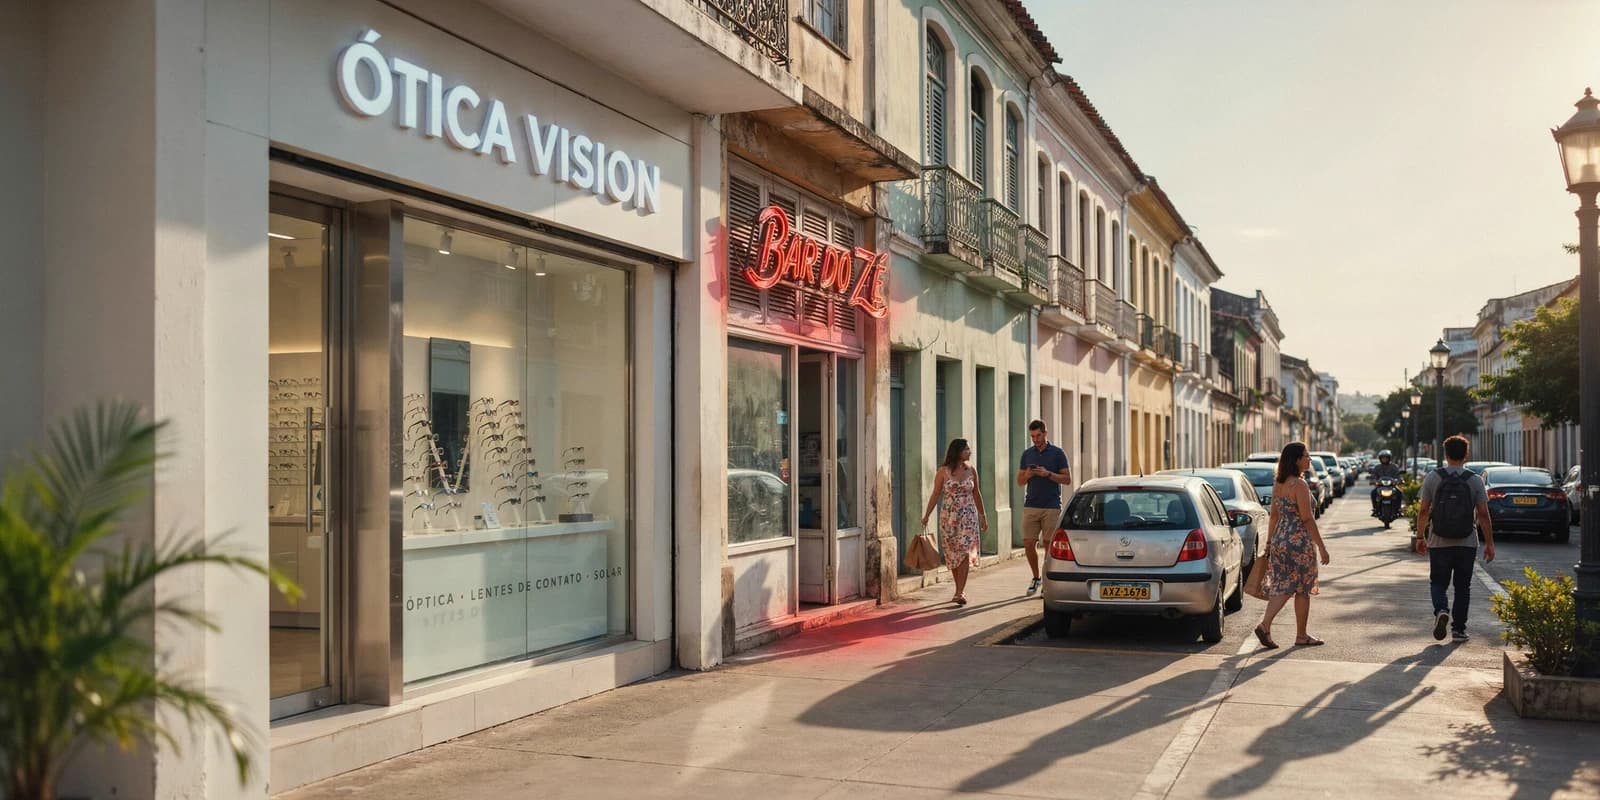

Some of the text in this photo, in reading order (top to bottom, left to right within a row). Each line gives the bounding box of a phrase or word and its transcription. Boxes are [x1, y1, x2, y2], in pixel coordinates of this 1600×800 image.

[337, 29, 661, 214] ÓTICA VISION
[470, 583, 513, 601] LENTES
[518, 580, 531, 593] DE
[535, 572, 582, 590] CONTATO
[593, 566, 623, 581] SOLAR
[1102, 587, 1148, 597] AXZ-1678
